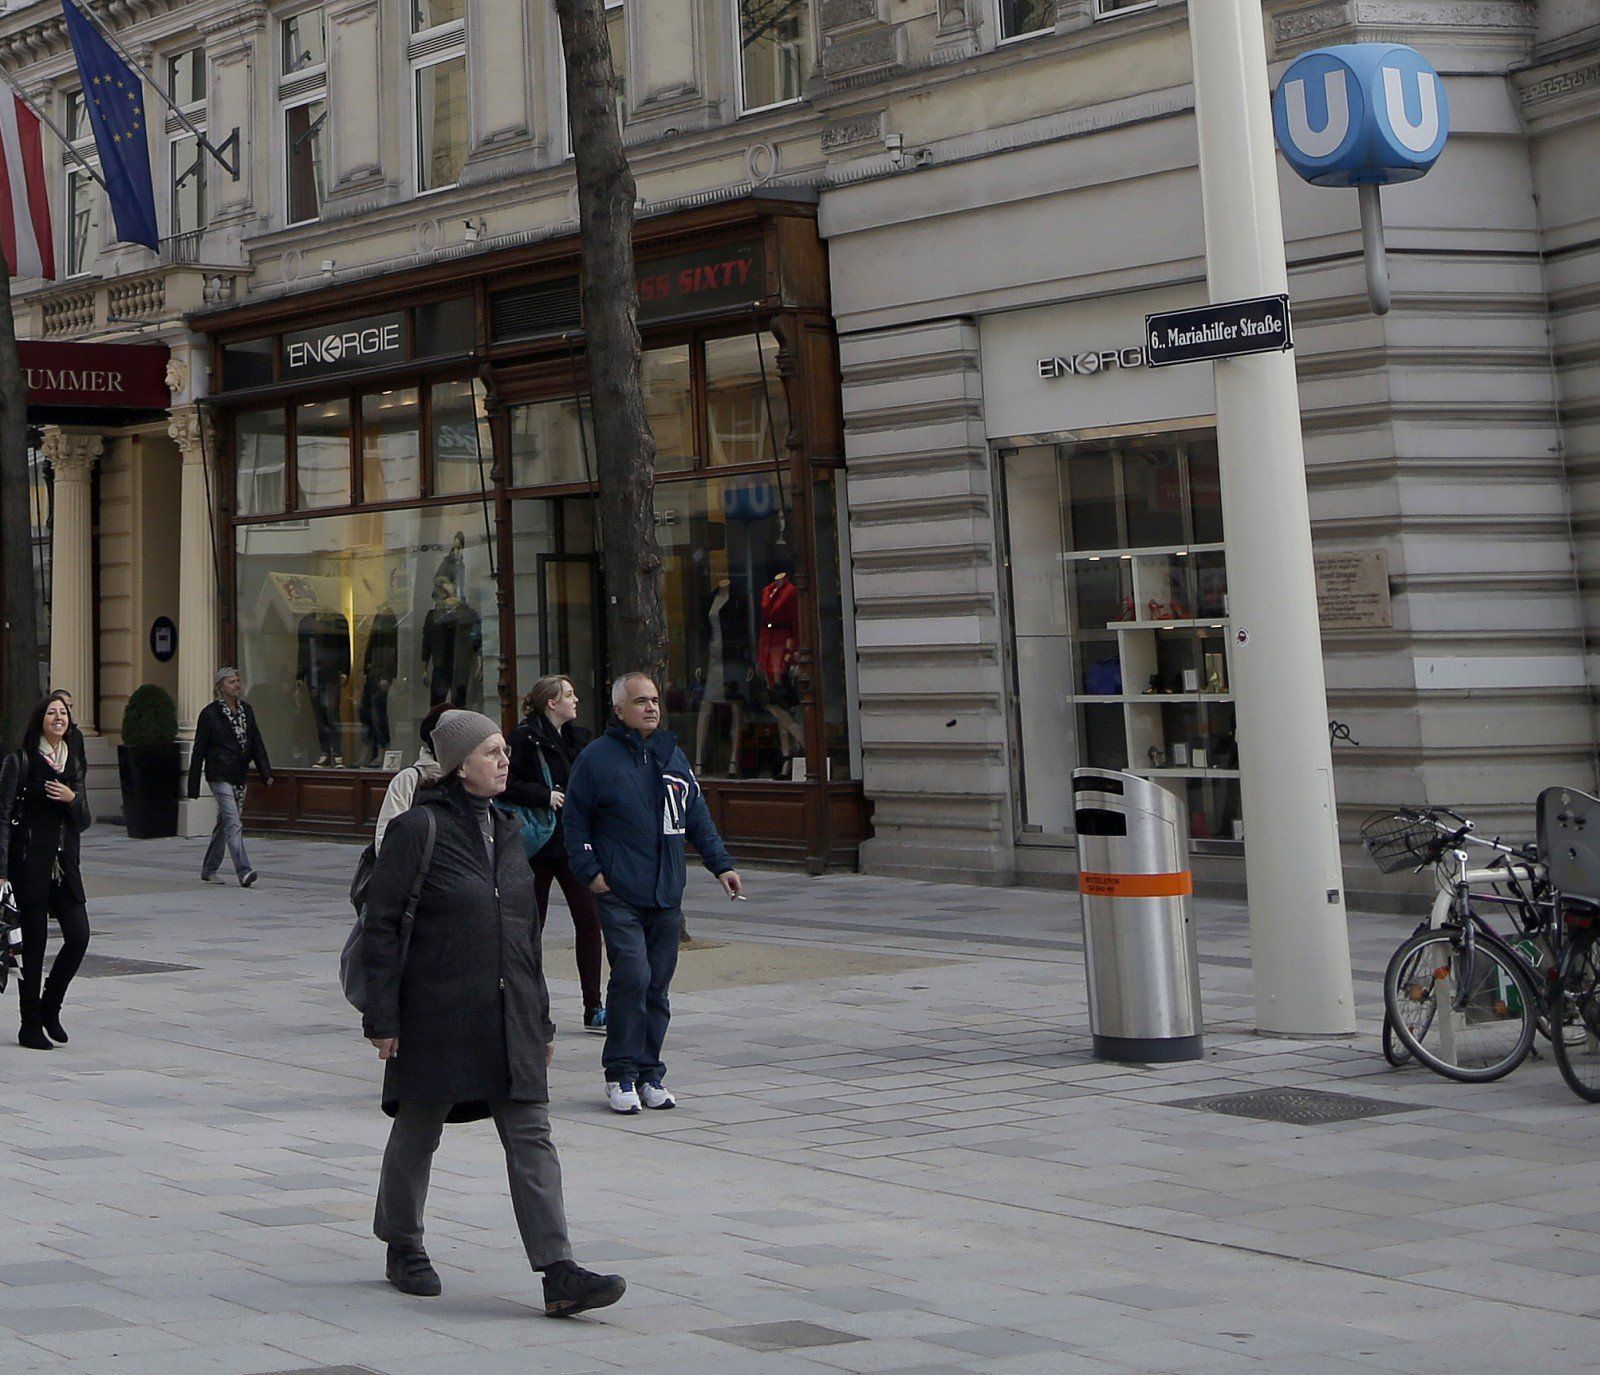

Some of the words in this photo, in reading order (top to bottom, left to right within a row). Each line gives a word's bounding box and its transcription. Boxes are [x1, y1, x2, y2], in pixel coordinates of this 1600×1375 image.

[1284, 68, 1349, 158] U
[1381, 65, 1439, 153] U
[677, 256, 754, 296] SIXTY
[1167, 321, 1238, 347] Mariahilfer
[1239, 314, 1282, 338] Straße
[23, 367, 124, 393] UMMER
